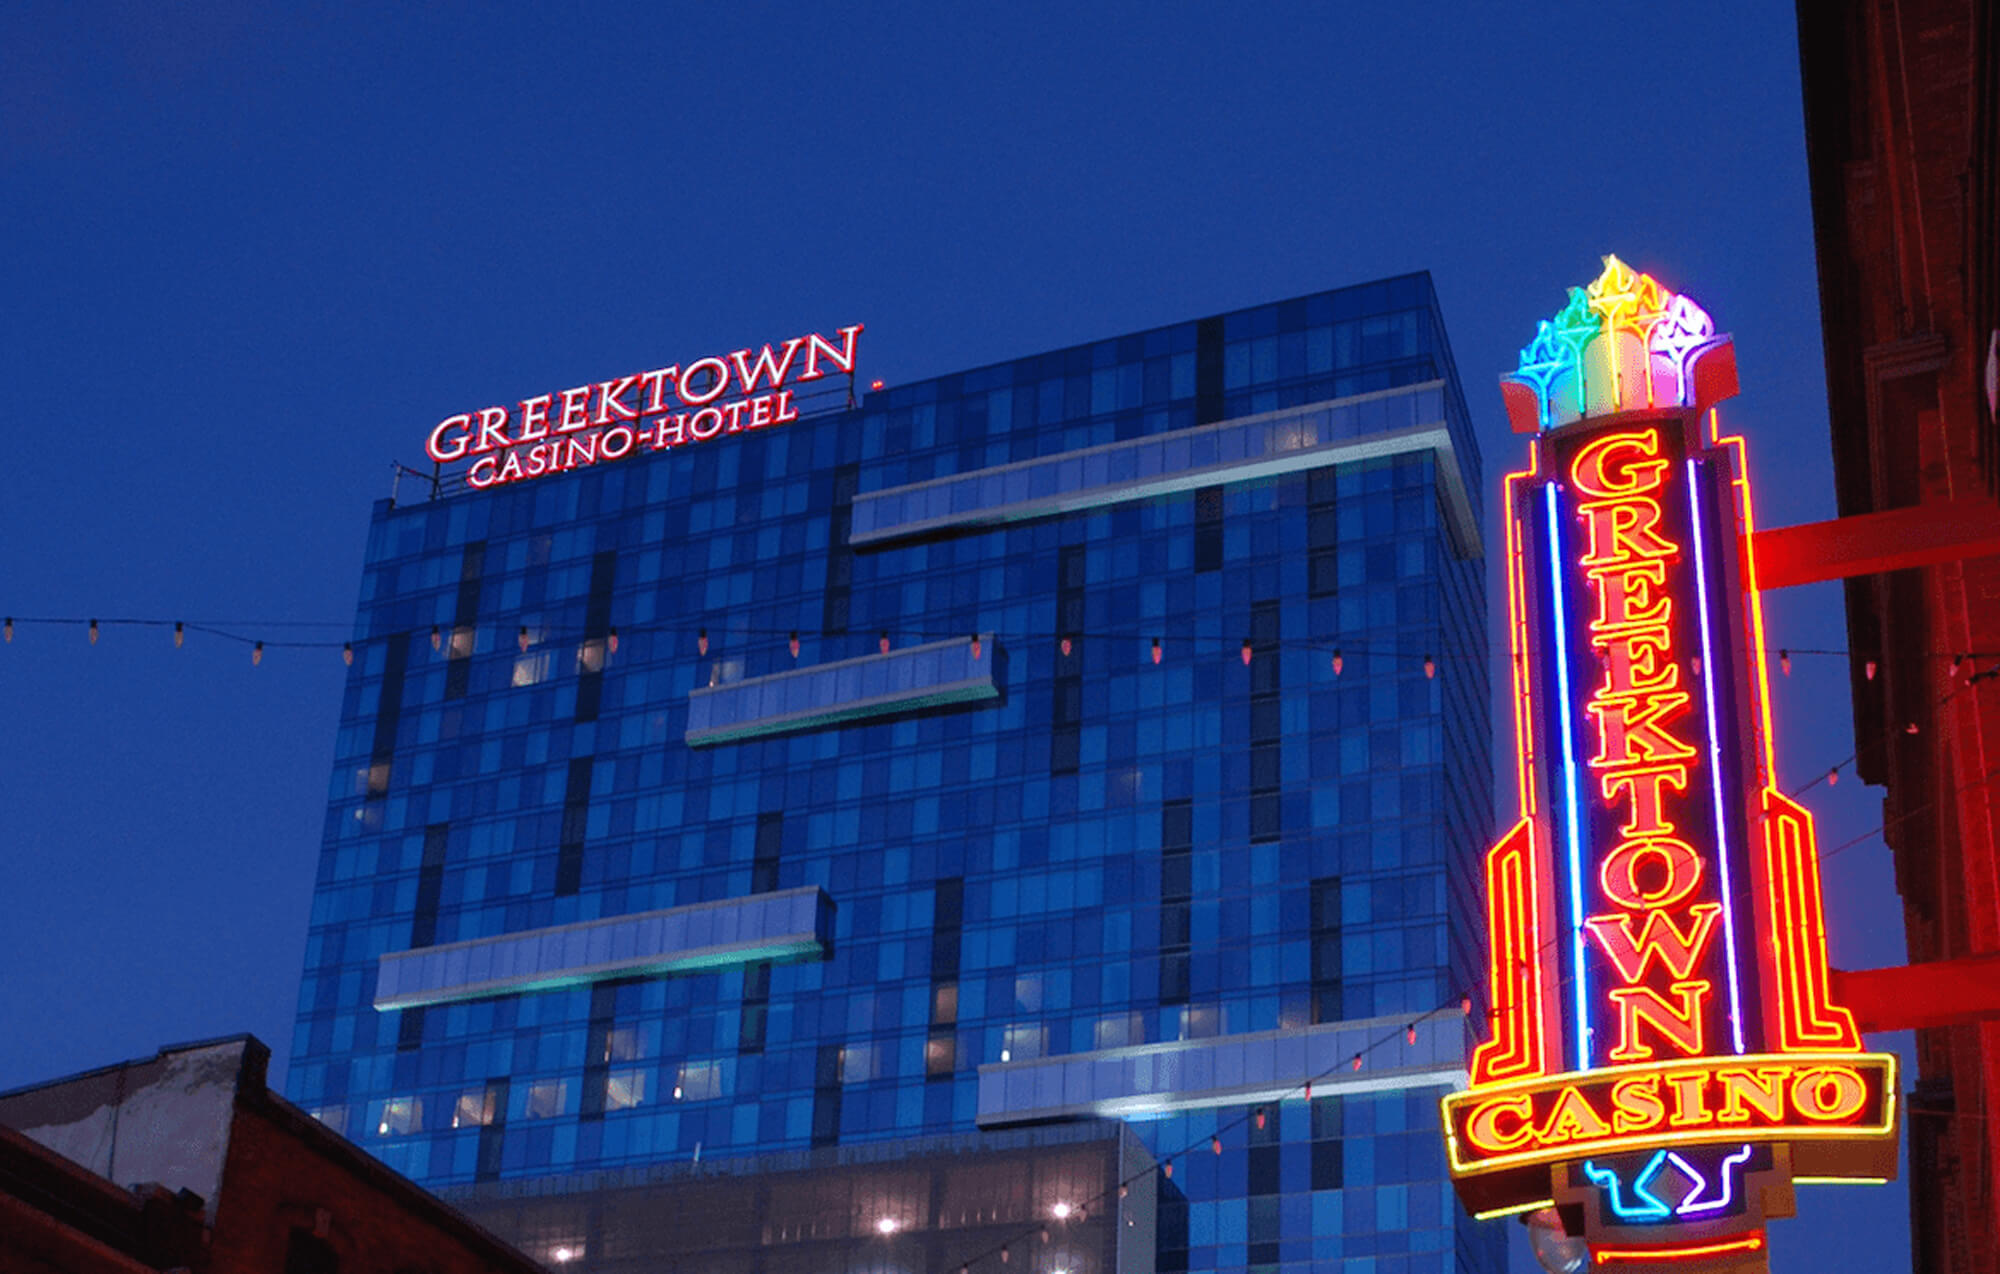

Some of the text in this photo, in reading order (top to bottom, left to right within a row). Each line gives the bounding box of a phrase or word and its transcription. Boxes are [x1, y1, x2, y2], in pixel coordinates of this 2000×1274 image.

[426, 324, 864, 462] GREEKTOWN
[467, 391, 799, 489] CASINO-HOTEL
[1571, 429, 1722, 1061] GREEKTOWN
[1466, 1066, 1867, 1151] CASINO
